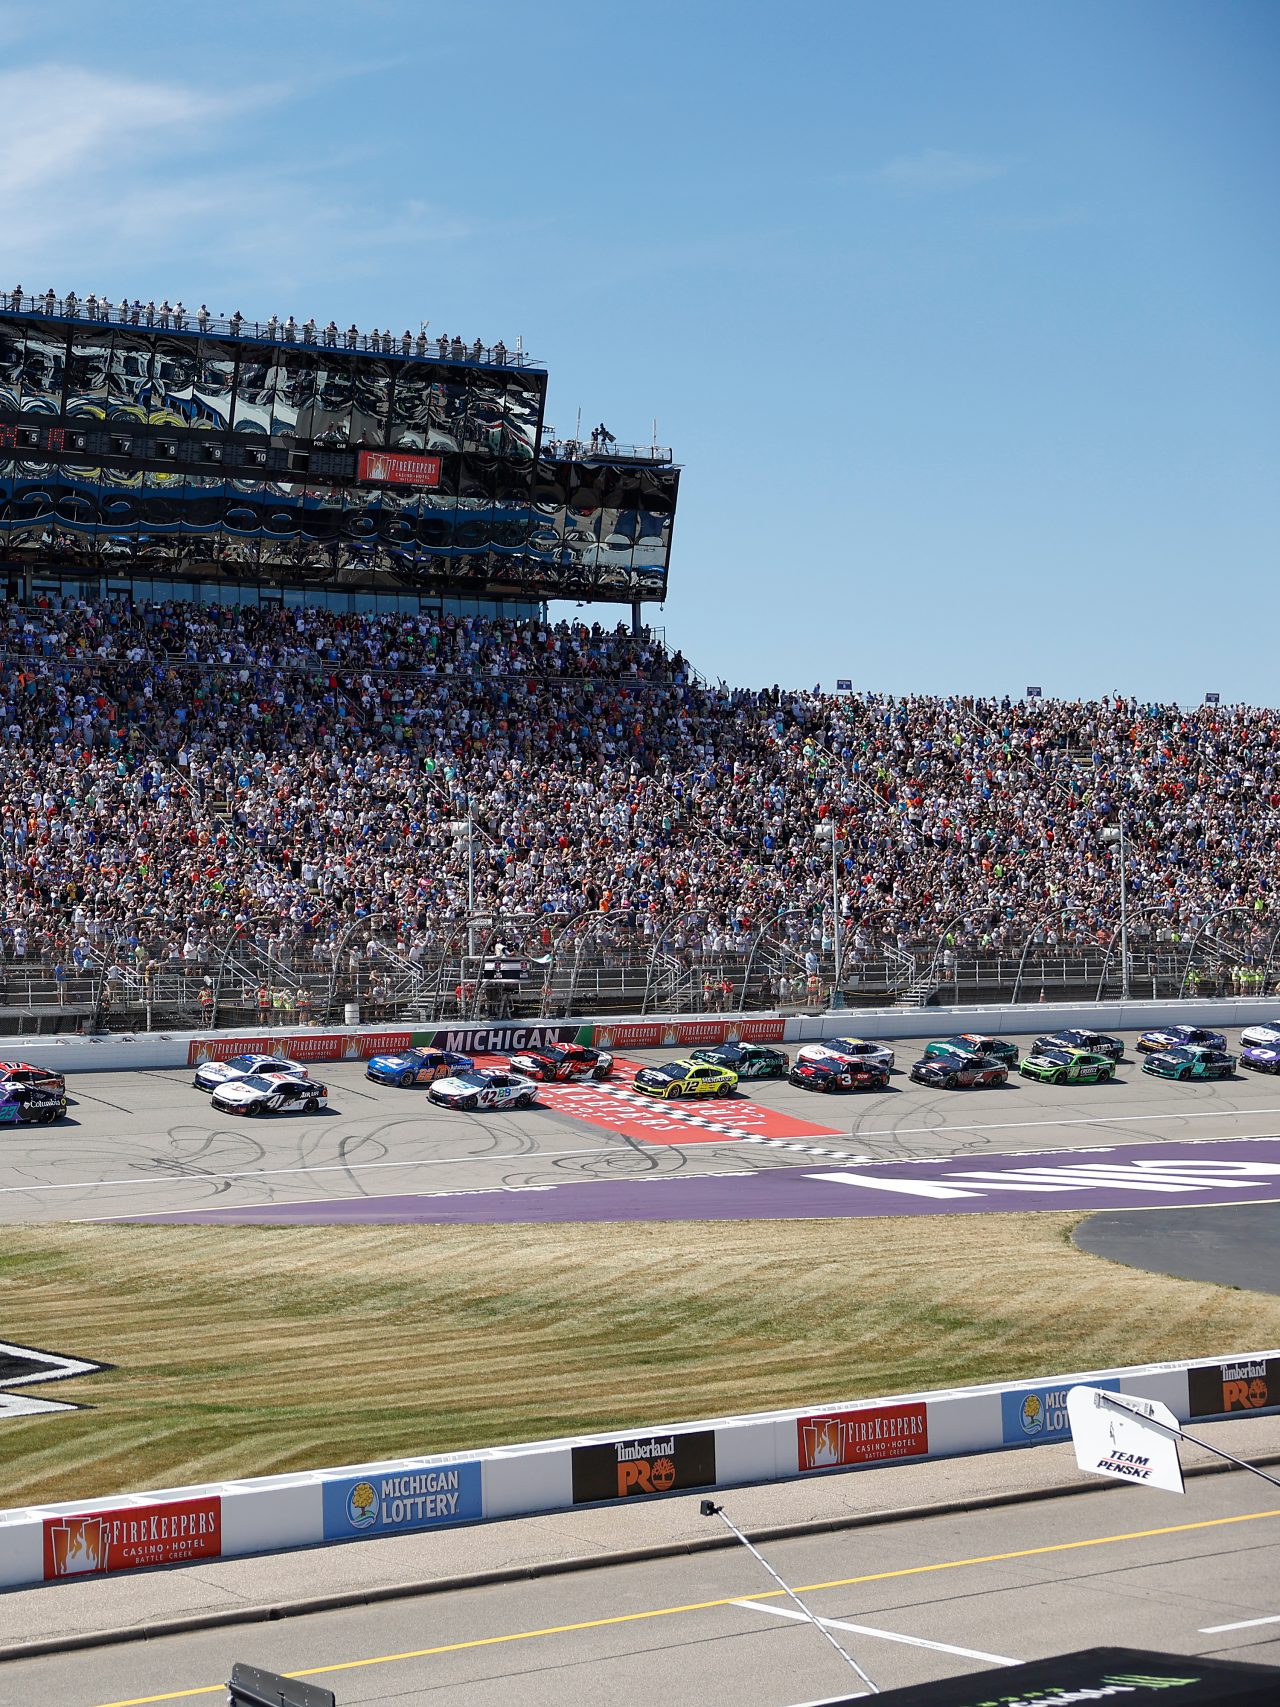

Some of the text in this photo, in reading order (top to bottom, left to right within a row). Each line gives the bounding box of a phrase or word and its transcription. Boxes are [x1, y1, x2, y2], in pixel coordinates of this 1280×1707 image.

[31, 433, 38, 443] 5
[77, 437, 84, 446] 6
[256, 452, 266, 462] 10
[618, 1027, 658, 1038] FIREKEEPERS
[681, 1025, 720, 1036] FIREKEEPERS
[744, 1023, 783, 1033] FIREKEEPERS
[366, 1037, 409, 1049] FIREKEEPERS
[445, 1028, 560, 1050] MICHIGAN
[218, 1042, 263, 1054] FIREKEEPERS
[292, 1040, 337, 1051] FIREKEEPERS
[560, 1063, 573, 1074] 71
[841, 1073, 852, 1085] 3
[684, 1081, 699, 1092] 12
[267, 1094, 285, 1109] 41
[481, 1091, 498, 1103] 42
[30, 1099, 60, 1108] Columbia
[1220, 1360, 1267, 1381] Timberland
[848, 1416, 923, 1443] FIREKEEPERS
[615, 1436, 675, 1461] Timberland
[856, 1438, 916, 1453] CASINO HOTEL
[1109, 1449, 1150, 1466] TEAM
[1097, 1460, 1152, 1479] PENSKE
[381, 1470, 458, 1499] MICHIGAN
[382, 1493, 459, 1524] LOTTERY
[112, 1511, 215, 1545] FIREKEEPERS
[123, 1539, 205, 1557] CASINO HOTEL
[135, 1550, 193, 1564] BATTLE CREEK
